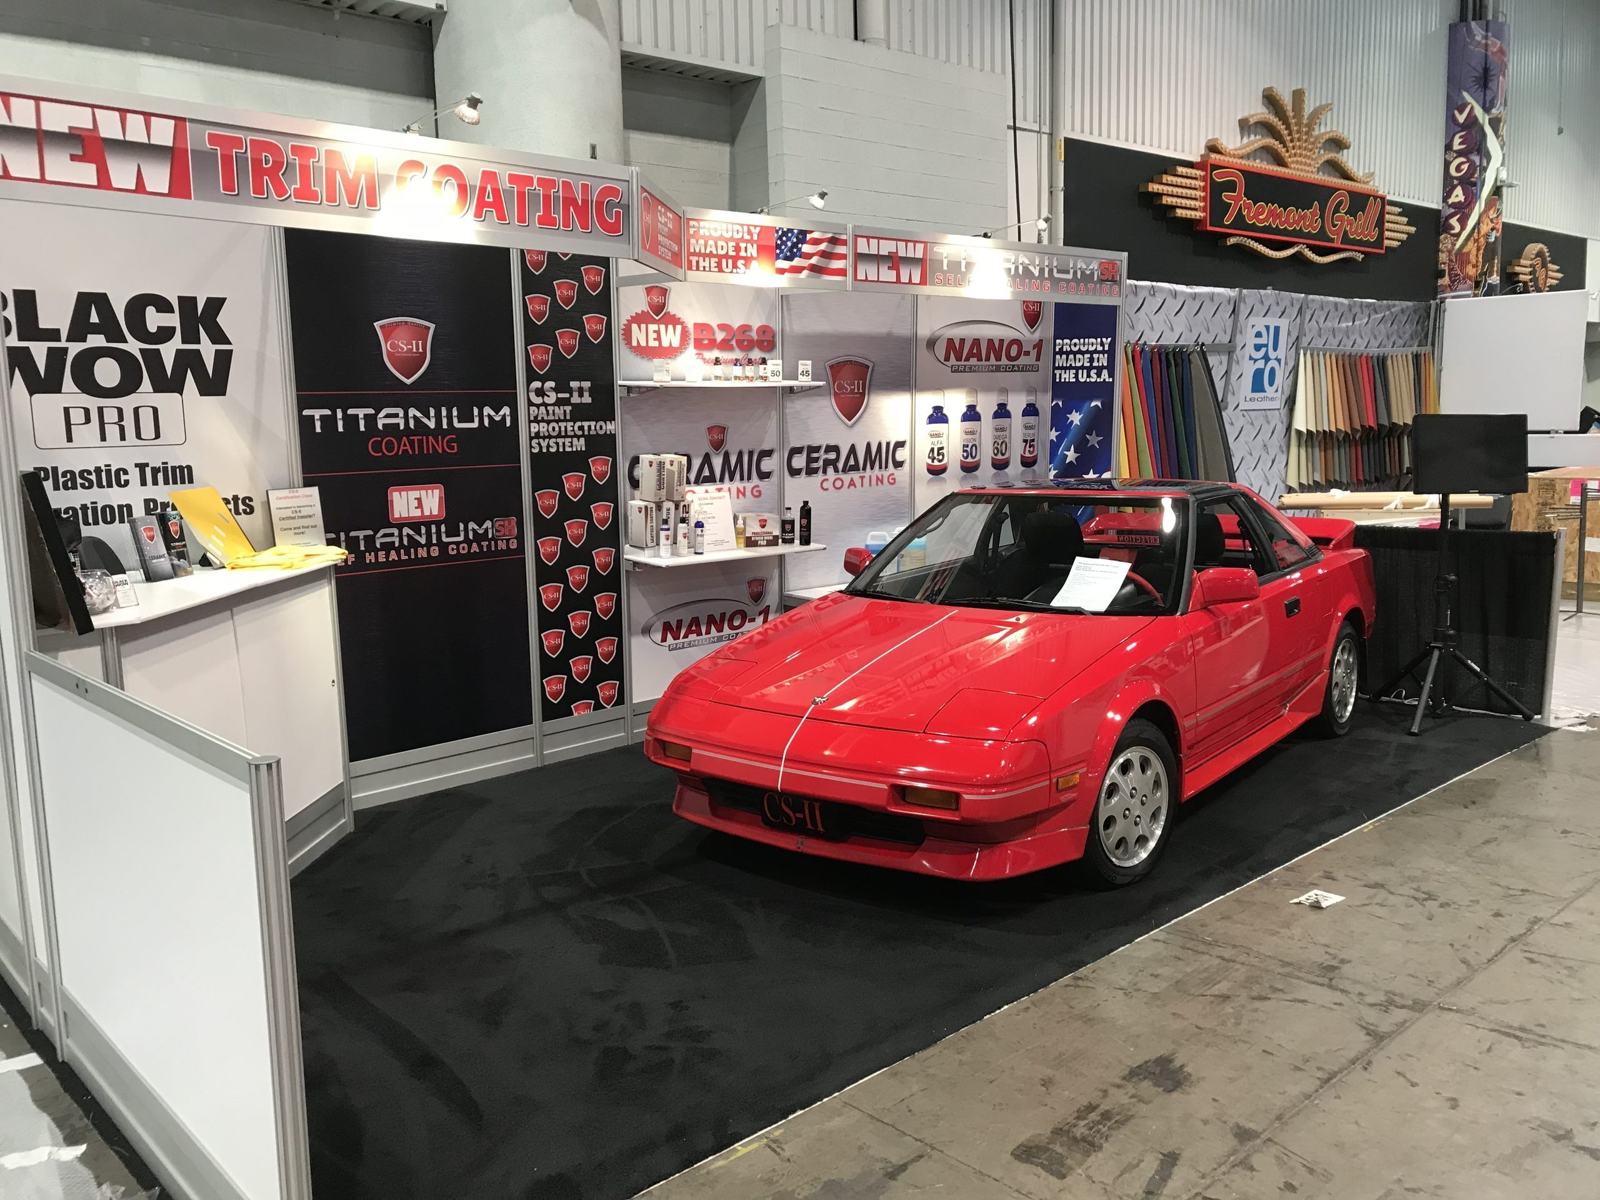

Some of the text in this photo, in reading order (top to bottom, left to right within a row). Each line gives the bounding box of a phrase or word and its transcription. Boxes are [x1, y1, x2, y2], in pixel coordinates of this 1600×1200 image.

[0, 95, 175, 194] NEW
[206, 131, 381, 210] TRIM
[1212, 169, 1382, 245] Fremont Grill
[689, 221, 760, 240] PROUDLY
[690, 239, 758, 257] MADE IN
[689, 256, 718, 272] THE
[857, 237, 925, 284] NEW
[934, 246, 1099, 282] TIANIUM
[1058, 282, 1120, 297] COATING
[0, 288, 233, 345] LACK
[1023, 302, 1041, 311] CS-II
[387, 339, 424, 353] CS-II
[631, 322, 776, 352] NEW B268
[1056, 338, 1111, 352] PROUDLY
[943, 338, 1044, 362] NANO-1
[1055, 353, 1107, 367] MADE IN
[6, 346, 233, 399] WOW
[770, 370, 781, 378] 50
[1000, 364, 1039, 372] COATING
[1054, 369, 1113, 382] THE U.S.A.
[528, 381, 592, 404] CS-II
[834, 380, 863, 394] CS-II
[302, 405, 511, 433] TITANIUM
[529, 405, 572, 420] PAINT
[63, 404, 161, 443] PRO
[530, 420, 615, 437] PROTECTION
[367, 435, 458, 457] COATING
[531, 438, 586, 453] SYSTEM
[928, 446, 945, 463] 45
[962, 443, 978, 460] 50
[993, 440, 1008, 457] 60
[1022, 439, 1036, 455] 75
[786, 440, 907, 478] CERAMIC
[33, 462, 194, 491] Plastic Trim
[628, 449, 775, 490] CAMIC
[820, 473, 897, 491] COATING
[392, 489, 440, 518] NEW
[326, 520, 516, 552] ITANIUM SH
[365, 546, 440, 564] HEALING
[448, 538, 518, 555] COATING
[660, 605, 770, 643] NANO-1
[669, 636, 718, 650] PREMIUM
[763, 792, 826, 833] CS-II
